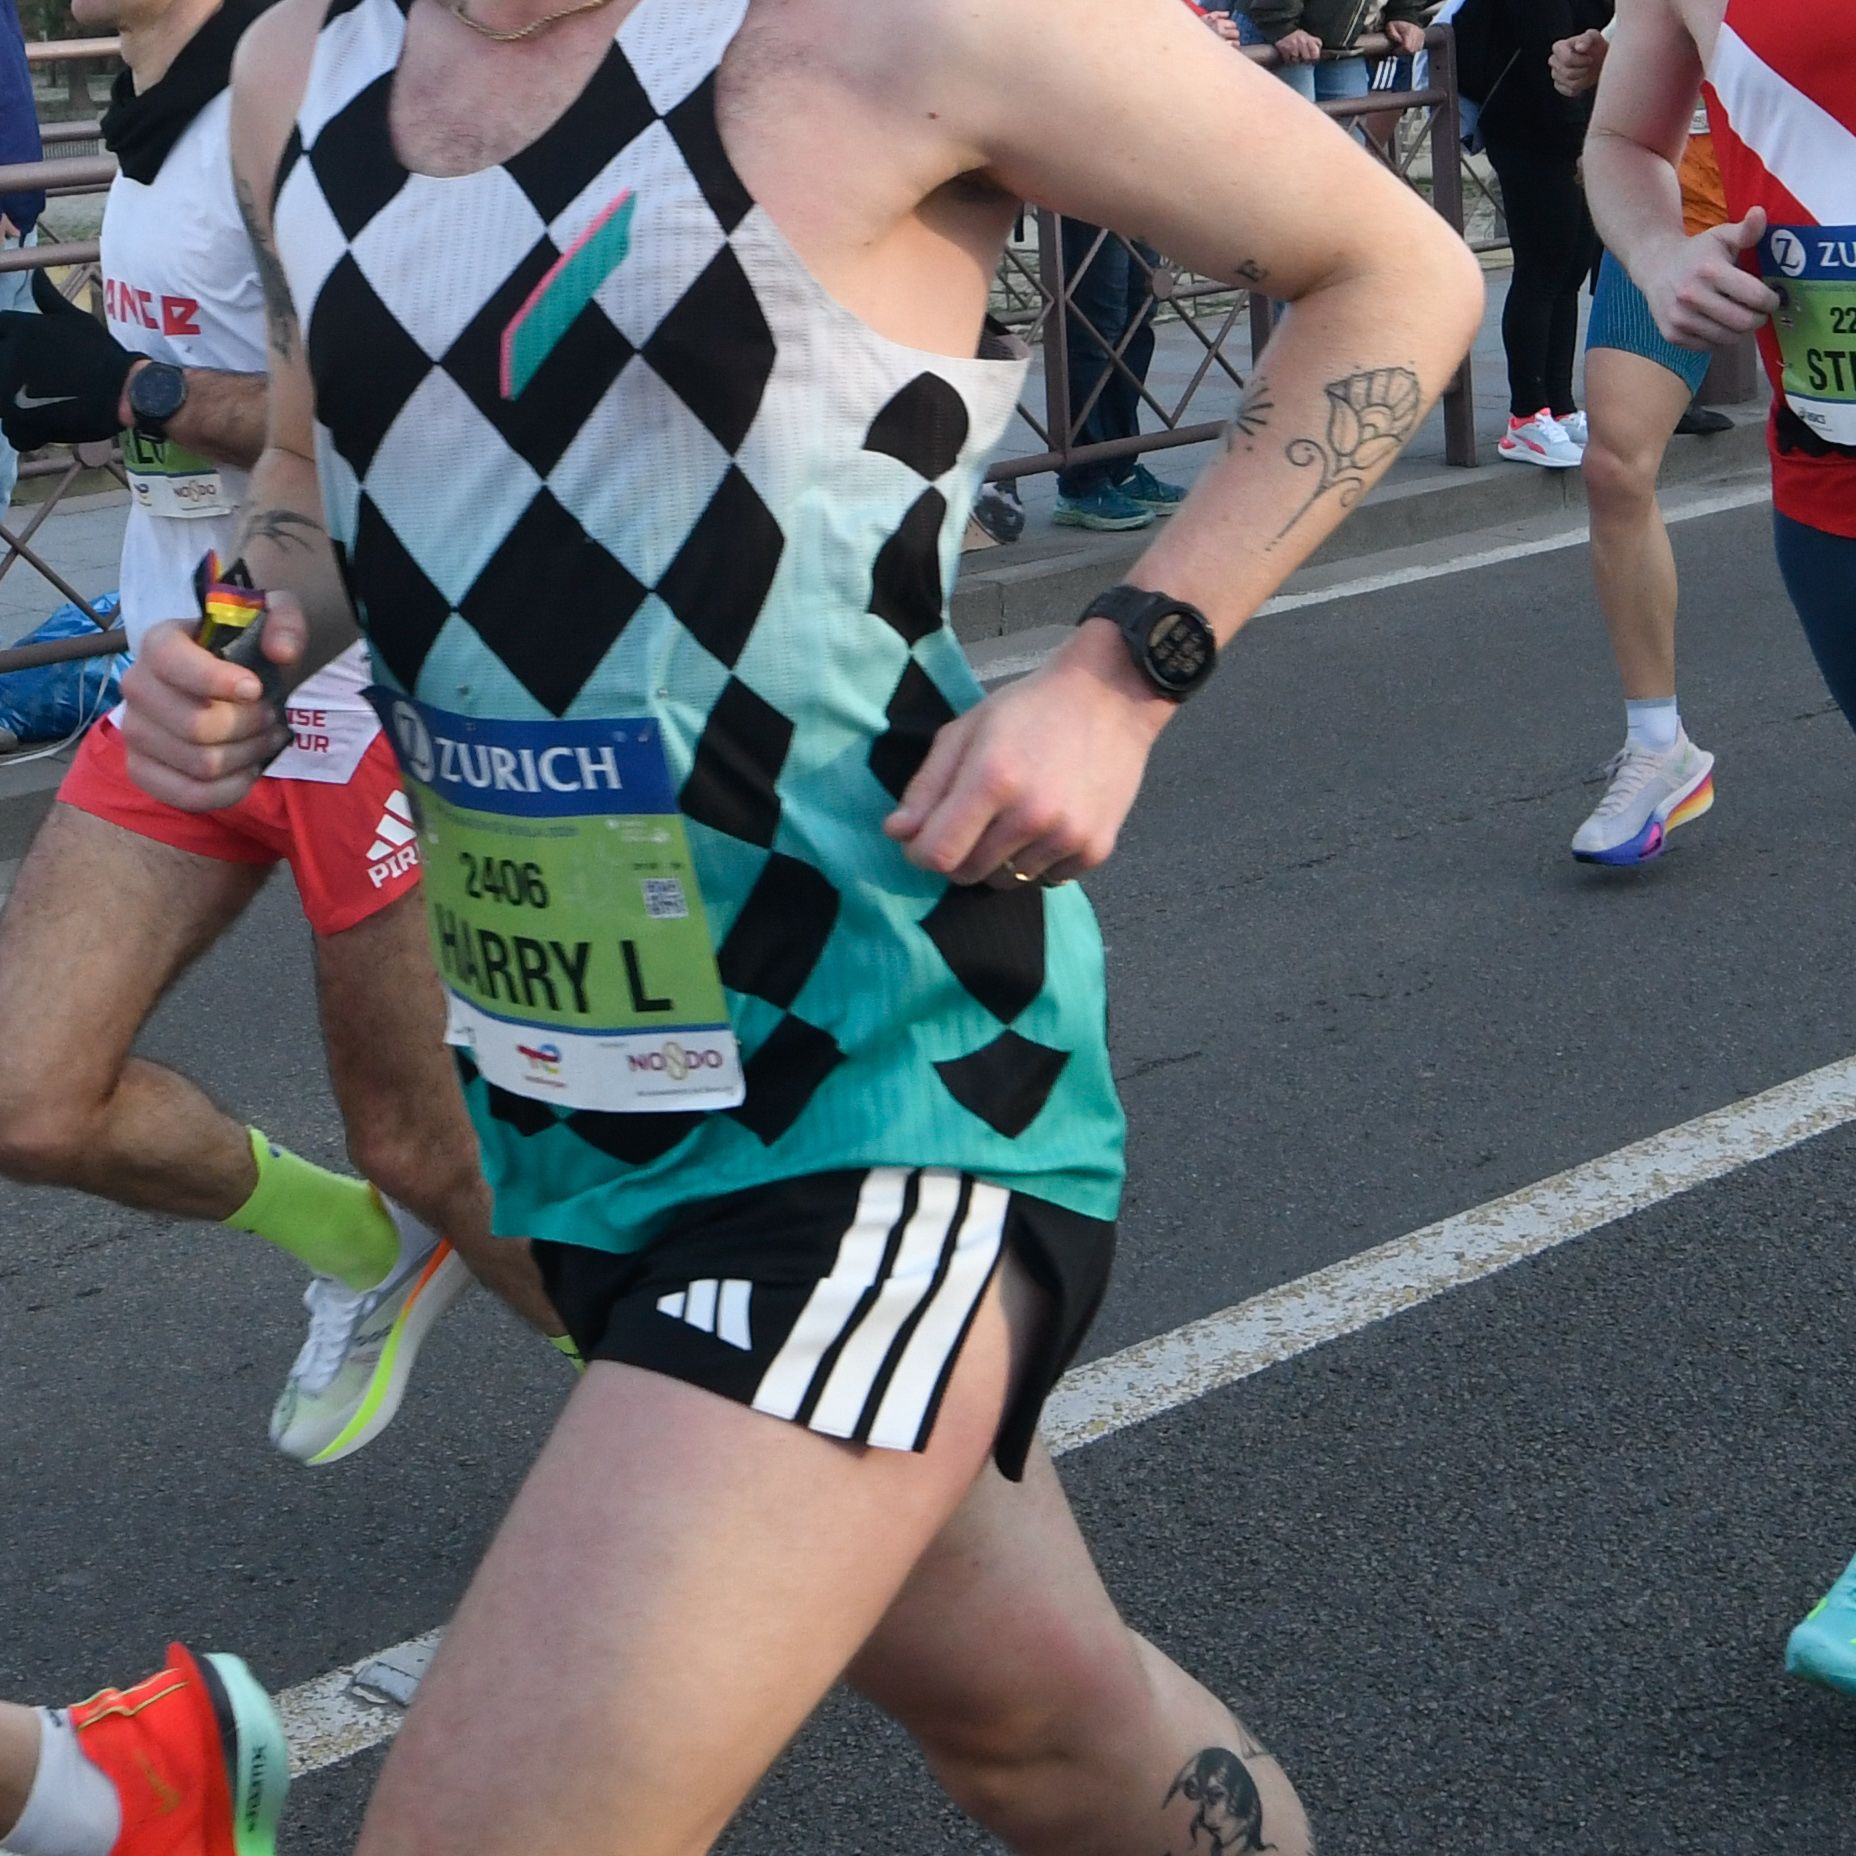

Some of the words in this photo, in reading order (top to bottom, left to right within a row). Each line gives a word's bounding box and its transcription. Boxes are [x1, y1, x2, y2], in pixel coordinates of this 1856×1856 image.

[290, 733, 330, 754] UR
[434, 736, 623, 793] ZURICH
[459, 852, 550, 909] 2406
[434, 903, 593, 1014] HARRY
[620, 939, 674, 1013] L
